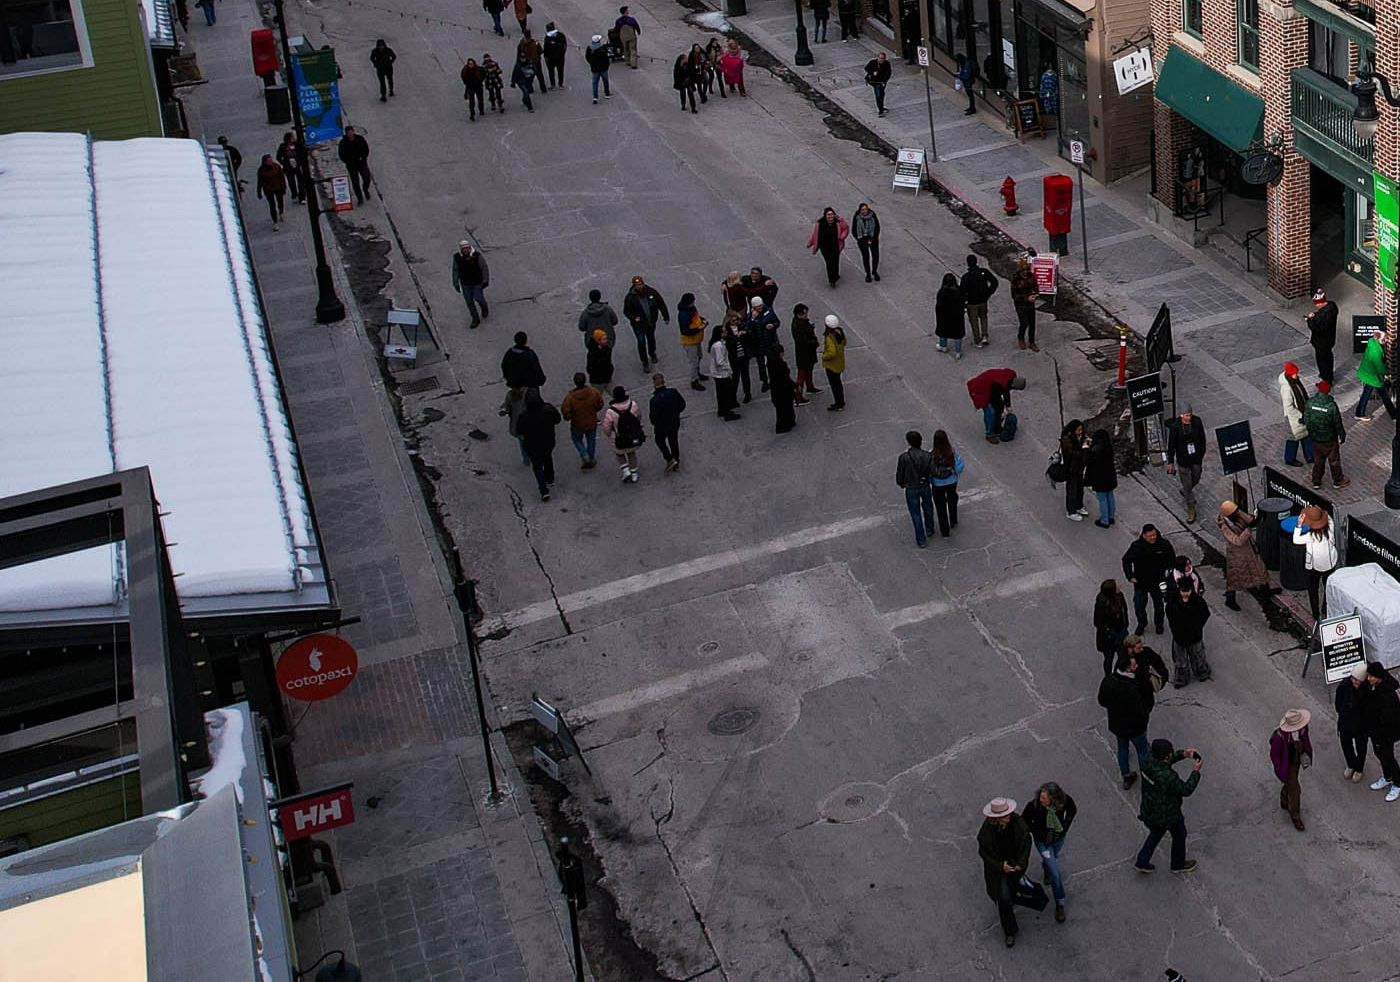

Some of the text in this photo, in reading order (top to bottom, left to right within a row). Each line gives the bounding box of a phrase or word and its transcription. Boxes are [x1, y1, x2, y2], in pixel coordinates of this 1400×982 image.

[1353, 531, 1381, 555] sundance
[1381, 548, 1395, 564] film
[286, 666, 352, 690] cotopaxi
[293, 799, 343, 831] HH
